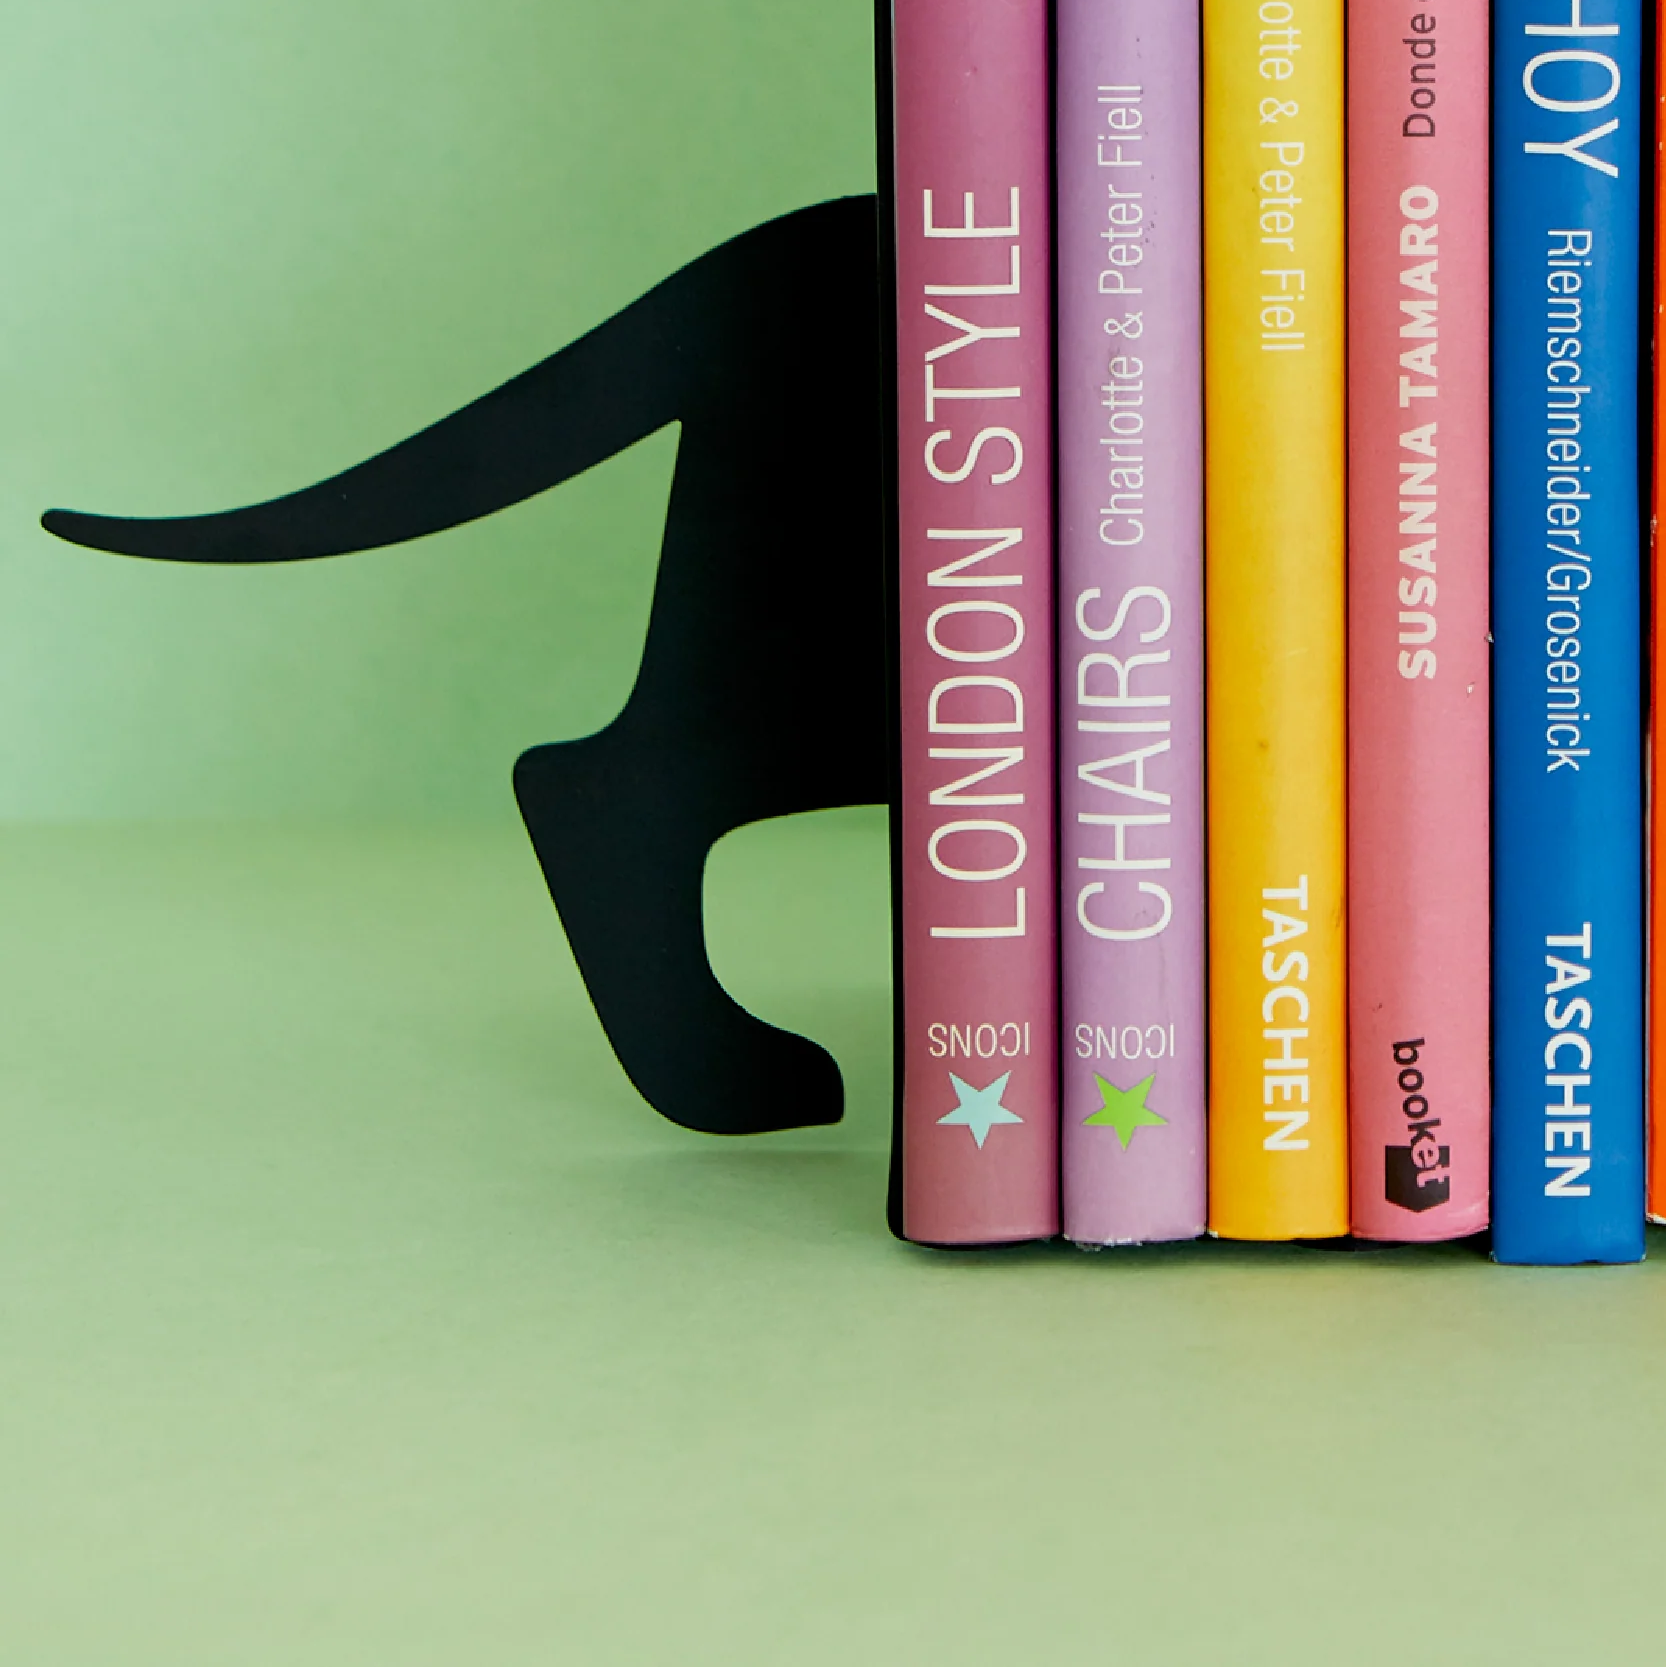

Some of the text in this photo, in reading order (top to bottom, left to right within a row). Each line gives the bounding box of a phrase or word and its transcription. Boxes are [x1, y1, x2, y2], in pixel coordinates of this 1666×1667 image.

[1258, 97, 1299, 125] &
[1402, 10, 1436, 138] Donde
[1258, 141, 1304, 252] Peter
[1097, 85, 1143, 546] Charlotte & Peter Fiell
[1260, 271, 1305, 351] Fiell
[1398, 186, 1438, 679] SUSANNA TAMARO
[1546, 230, 1592, 773] Riemschneider/Grosenick
[924, 186, 1027, 939] LONDON STYLE
[1076, 584, 1171, 940] CHAIRS
[929, 1023, 1030, 1057] ICONS
[1076, 1025, 1174, 1058] ICONS
[1262, 875, 1309, 1152] TASCHEN
[1391, 1038, 1450, 1187] booket
[1544, 921, 1591, 1198] TASCHEN
